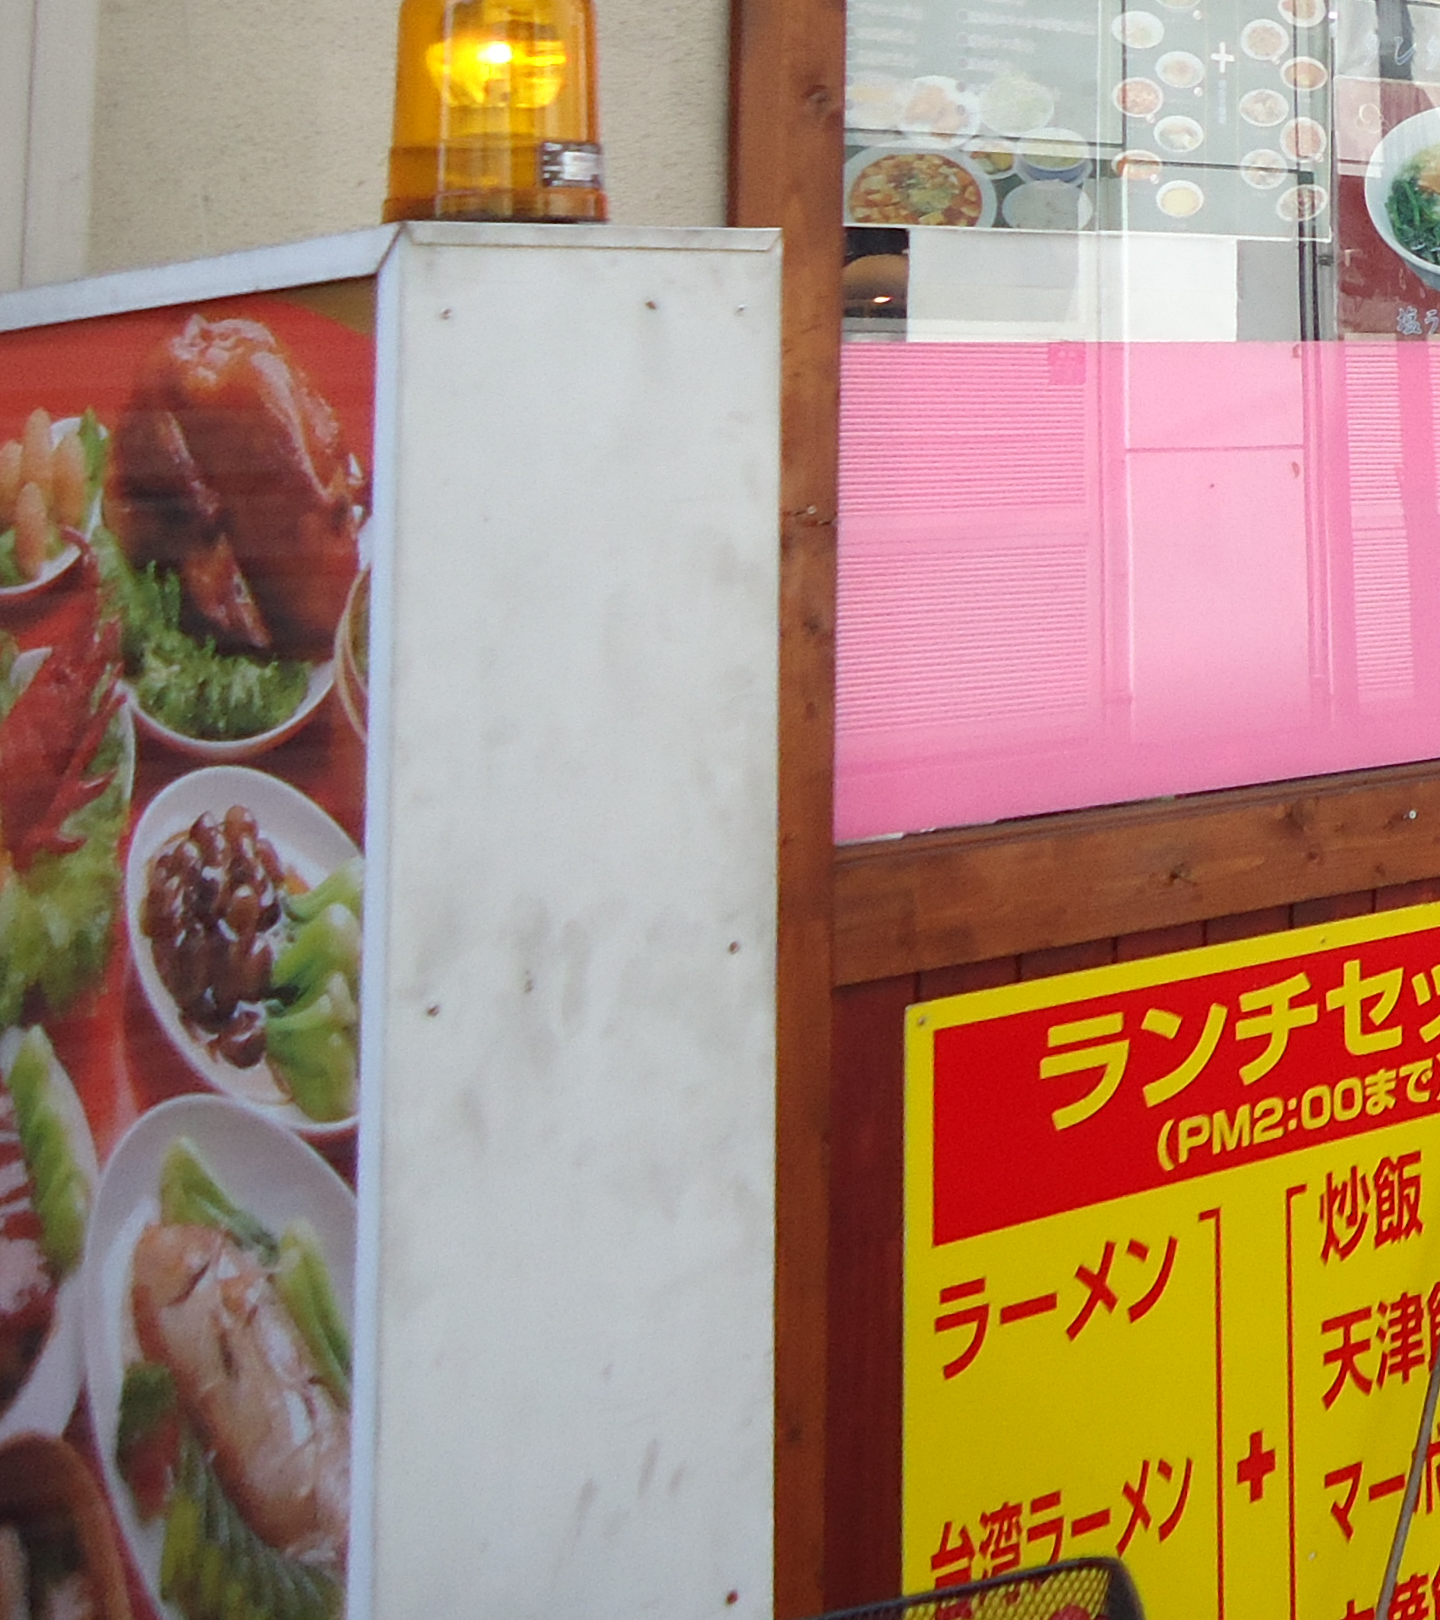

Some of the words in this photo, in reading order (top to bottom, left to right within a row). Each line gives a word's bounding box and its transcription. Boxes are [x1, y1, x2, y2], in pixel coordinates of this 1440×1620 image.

[1318, 1150, 1424, 1266] 炒飯
[934, 1235, 1179, 1379] ラーメン
